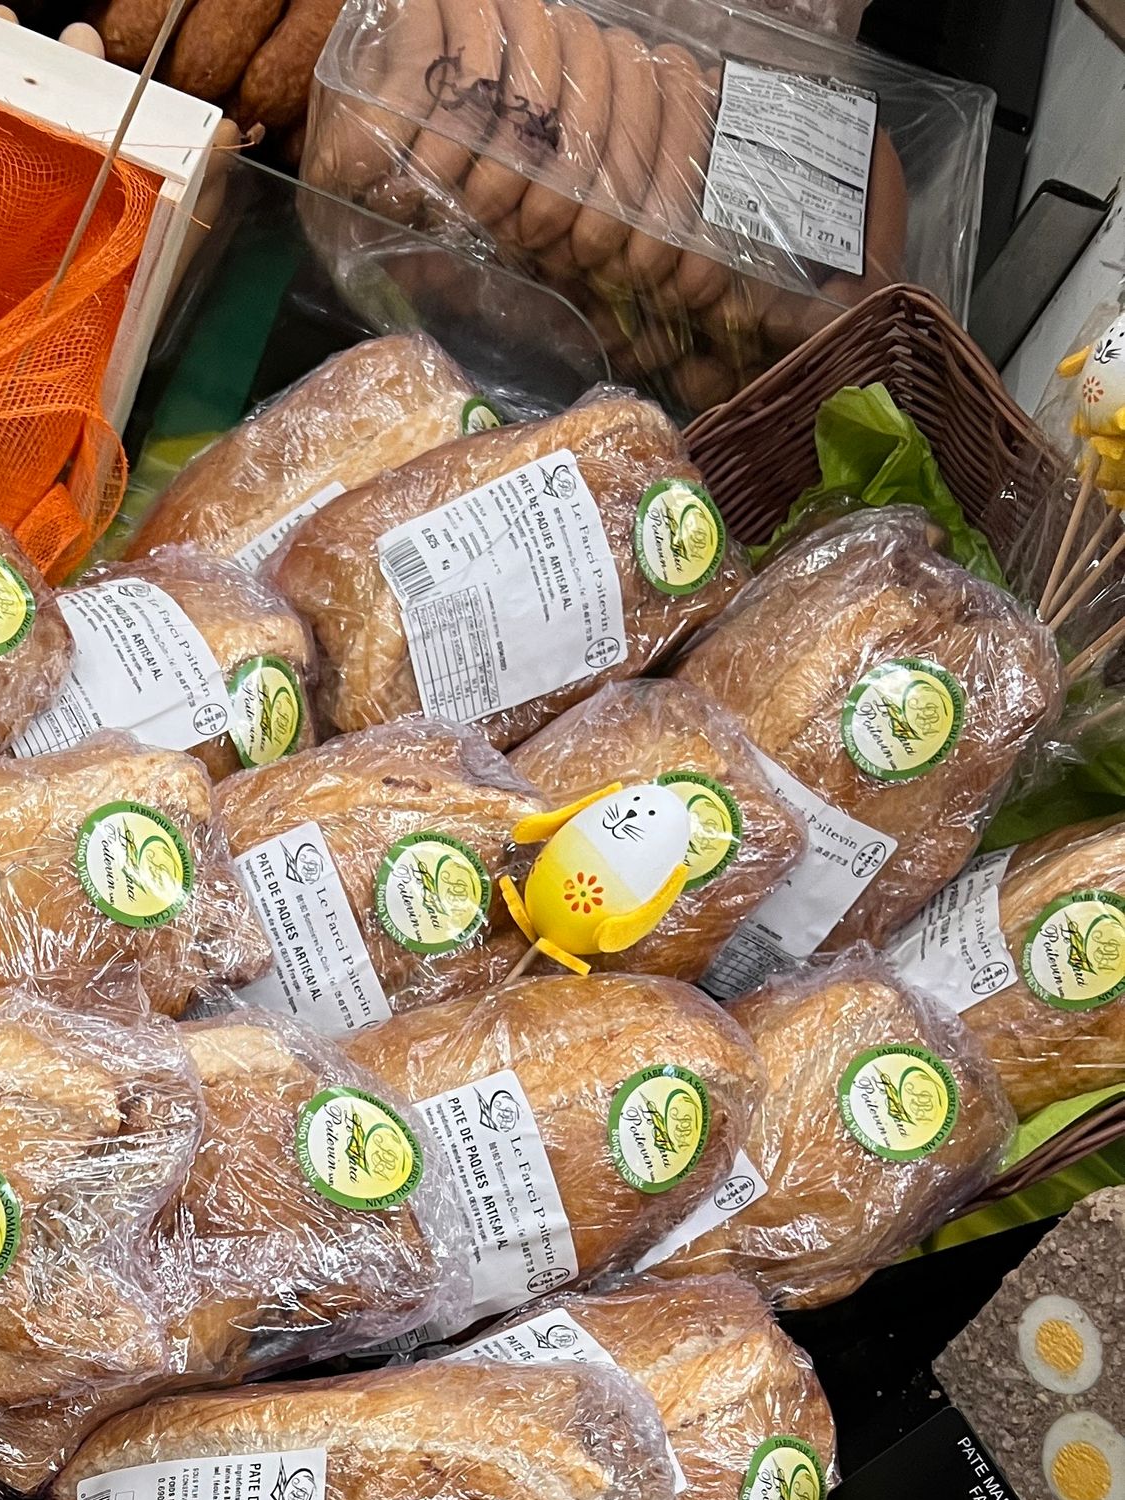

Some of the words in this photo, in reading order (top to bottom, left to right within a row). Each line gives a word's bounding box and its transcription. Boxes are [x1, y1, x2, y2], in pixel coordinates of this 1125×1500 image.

[420, 527, 440, 549] 0.625
[440, 559, 452, 571] Kg
[515, 473, 535, 495] PATE
[527, 495, 539, 510] DE
[533, 510, 555, 550] PAQUES
[548, 553, 574, 611] ARTISANAL
[569, 501, 584, 521] Le
[577, 523, 598, 564] Farci
[591, 567, 610, 632] Poitevin
[853, 700, 893, 759] Poitevin
[129, 805, 173, 834] FABRIQUE
[77, 833, 89, 861] 86160
[254, 851, 275, 880] PATE
[77, 866, 102, 902] VIENNE
[266, 880, 282, 897] DE
[377, 883, 387, 913] 86160
[391, 863, 418, 929] Poitevin
[271, 897, 300, 941] PAQUES
[381, 911, 408, 945] VIENNE
[314, 886, 331, 909] Le
[323, 910, 349, 952] Farci
[340, 954, 373, 1016] Poitevin
[1038, 922, 1061, 985] Poitevin
[291, 943, 324, 1003] ARTISANAL
[298, 1111, 313, 1139] 86160
[446, 1096, 468, 1125] PATE
[853, 1075, 887, 1136] Poitevin
[323, 1104, 345, 1171] Poitevin
[458, 1126, 474, 1143] DE
[508, 1135, 526, 1158] Le
[620, 1106, 654, 1171] Poitevin
[298, 1141, 319, 1183] VIENNE
[464, 1144, 489, 1189] PAQUES
[516, 1160, 541, 1204] Farci
[616, 1158, 646, 1189] VIENNE
[480, 1193, 510, 1251] ARTISANAL
[532, 1206, 556, 1265] Poitevin
[248, 1462, 261, 1490] PATE
[956, 1435, 989, 1477] PATE
[156, 1476, 164, 1500] 0.690
[167, 1475, 175, 1497] POIDS
[222, 1484, 230, 1494] de
